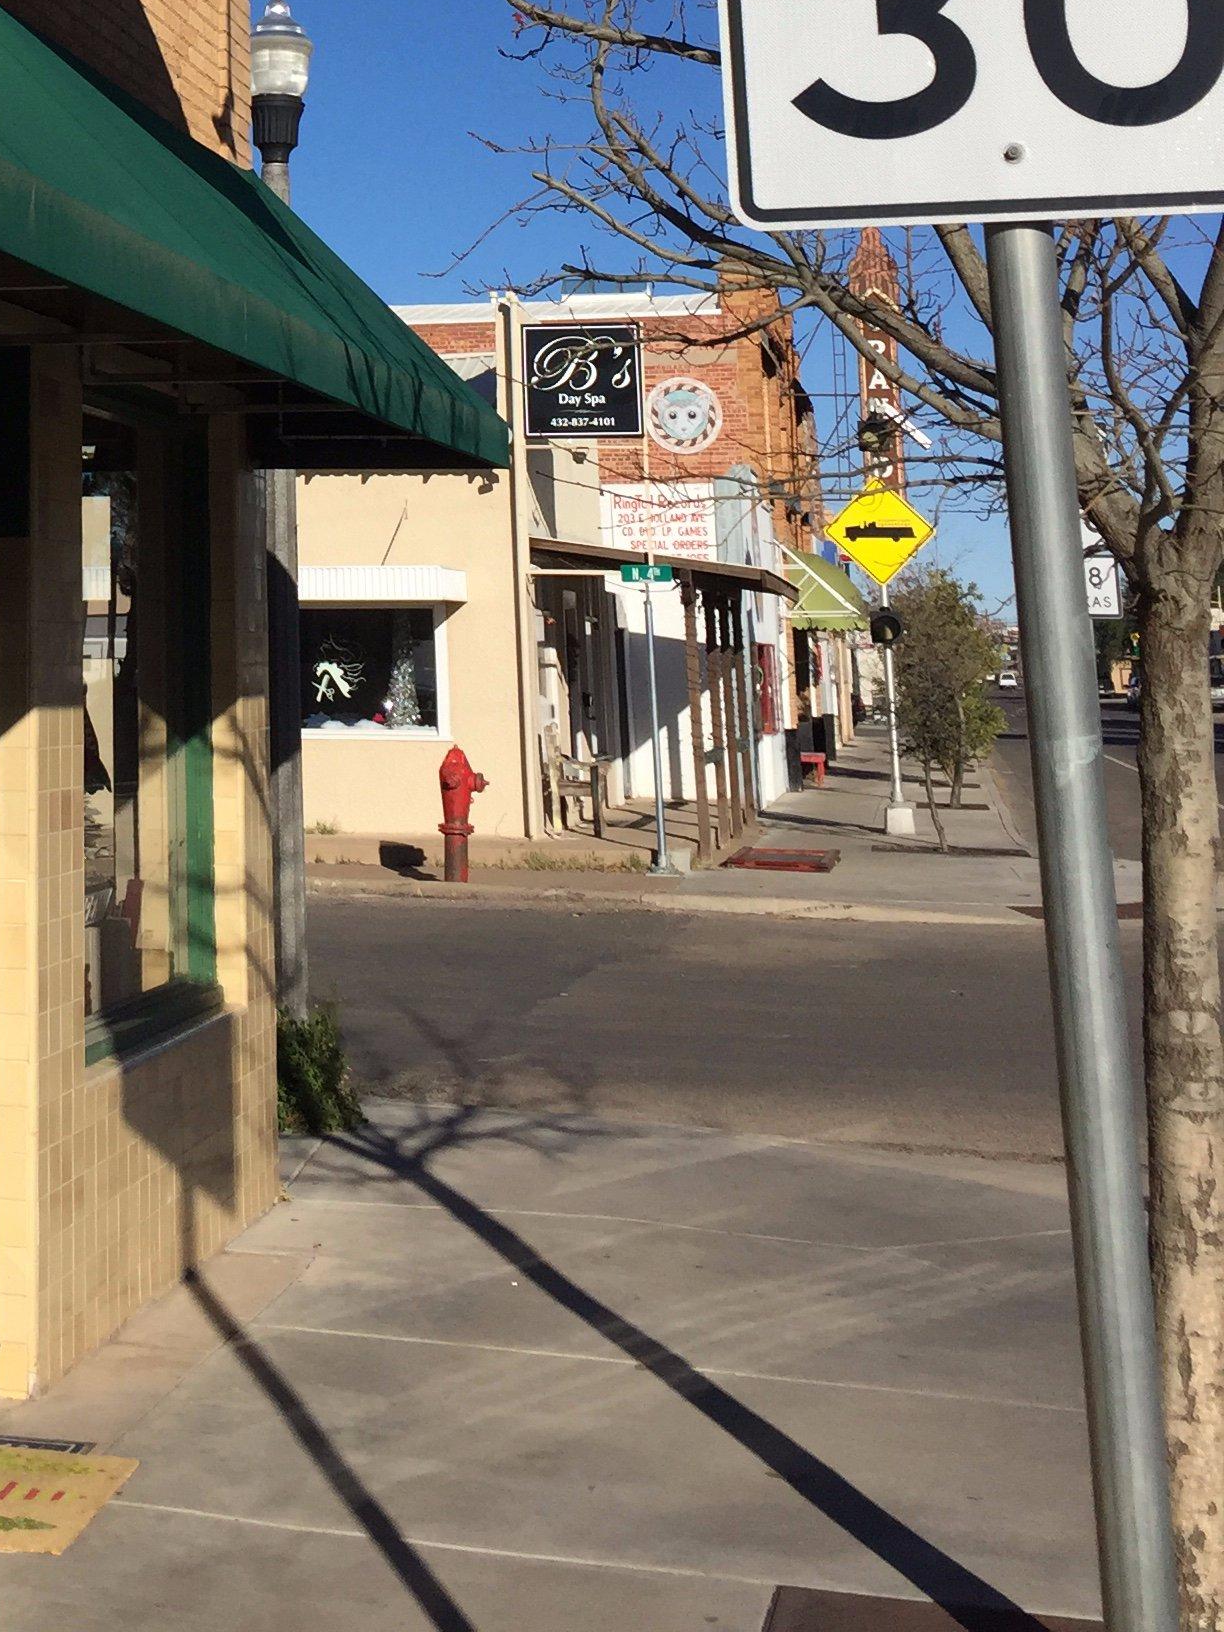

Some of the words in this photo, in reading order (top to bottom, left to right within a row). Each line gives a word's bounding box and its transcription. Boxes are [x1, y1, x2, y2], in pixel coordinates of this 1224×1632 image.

[531, 335, 632, 391] B's
[558, 393, 582, 408] Day
[584, 392, 606, 408] Spa
[550, 416, 616, 428] 432-837-4101
[613, 494, 654, 512] RingTl
[657, 494, 707, 509] Rcords
[621, 527, 634, 537] CD
[677, 527, 708, 537] GAMES
[630, 540, 669, 550] SPEIAL
[672, 540, 710, 550] ORDERS
